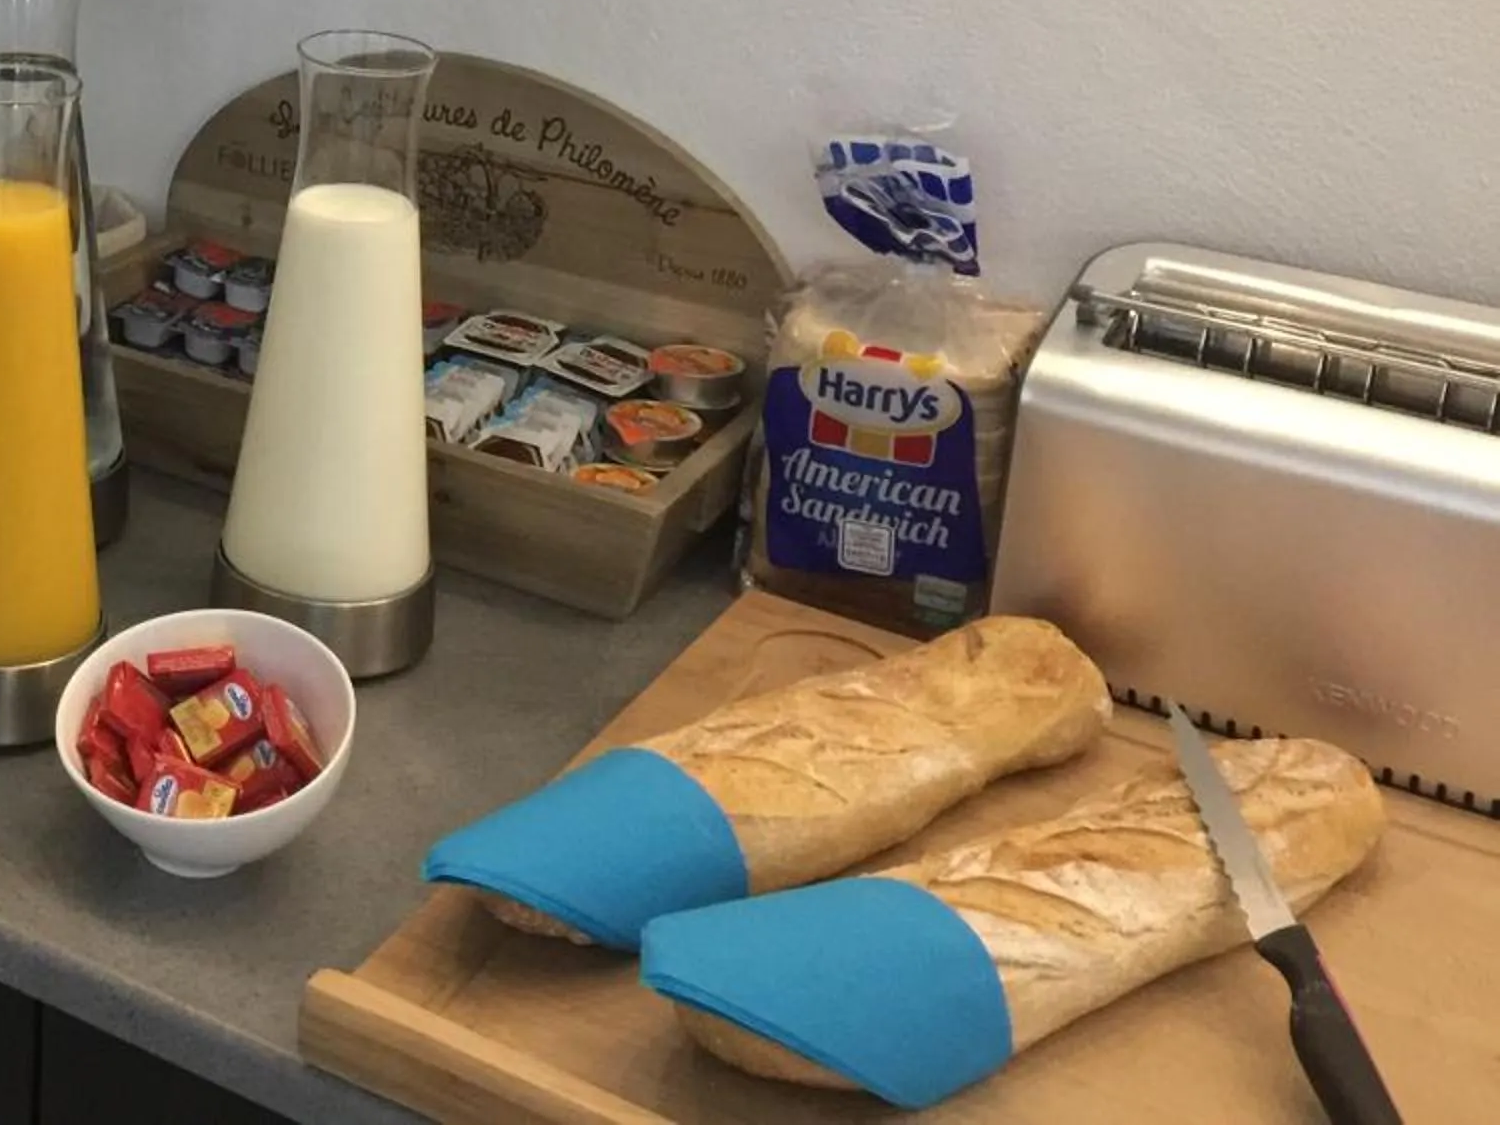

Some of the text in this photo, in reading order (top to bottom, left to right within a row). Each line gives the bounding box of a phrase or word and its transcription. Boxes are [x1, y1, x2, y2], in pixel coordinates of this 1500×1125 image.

[490, 108, 527, 142] de
[537, 116, 681, 226] Philomène
[781, 447, 963, 516] American
[781, 482, 949, 549] Sandwich
